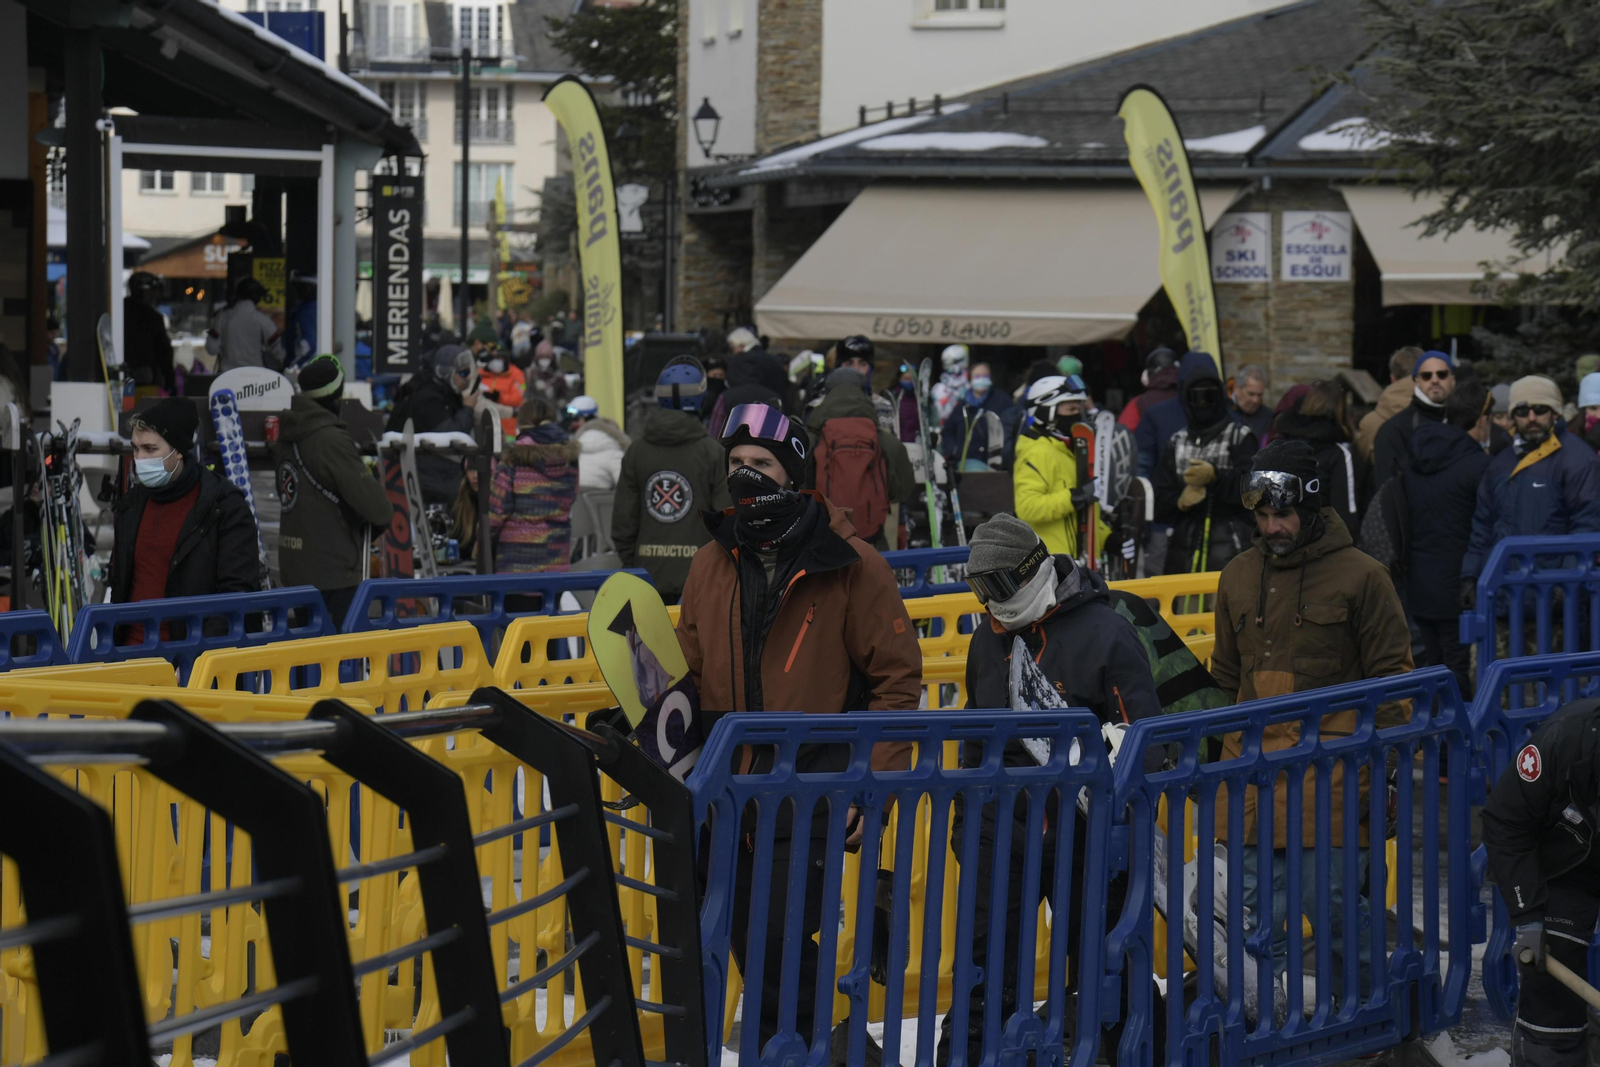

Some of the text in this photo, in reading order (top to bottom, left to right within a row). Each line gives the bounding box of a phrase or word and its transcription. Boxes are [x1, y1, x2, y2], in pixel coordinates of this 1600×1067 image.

[1226, 249, 1256, 262] SKI
[1285, 244, 1347, 255] ESCUELA
[1215, 265, 1268, 278] SCHOOL
[387, 208, 410, 365] MERIENDAS
[941, 319, 1011, 340] BLANCO
[1019, 549, 1044, 576] SMITH
